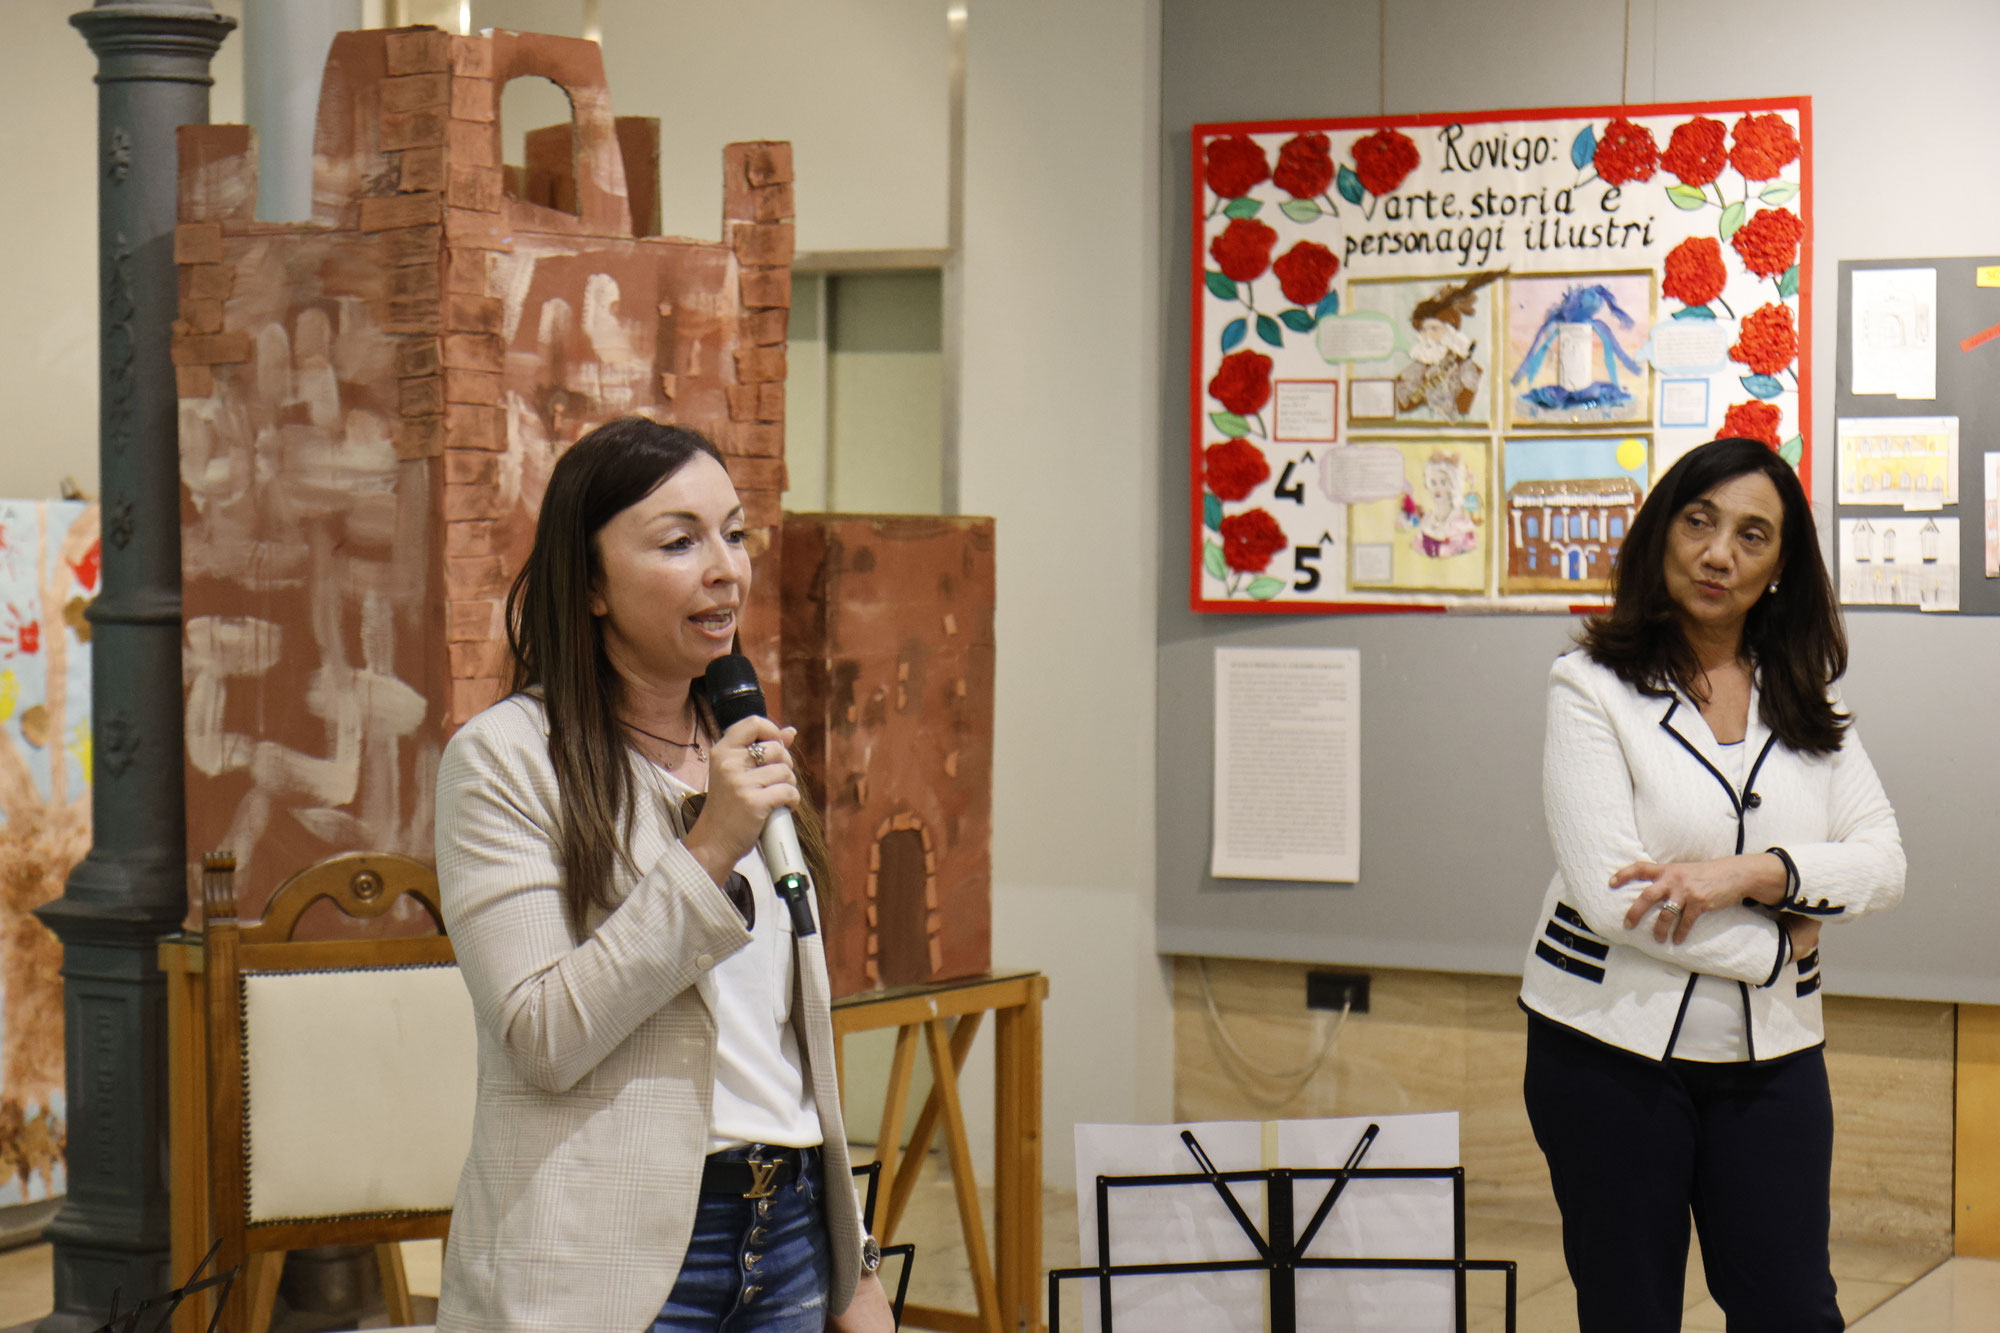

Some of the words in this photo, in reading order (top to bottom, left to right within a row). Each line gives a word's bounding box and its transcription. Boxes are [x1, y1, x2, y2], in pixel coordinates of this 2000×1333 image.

[1438, 122, 1559, 173] Rovigo:
[1601, 187, 1621, 212] e
[1345, 220, 1505, 267] personaggi
[1525, 216, 1655, 250] illustri
